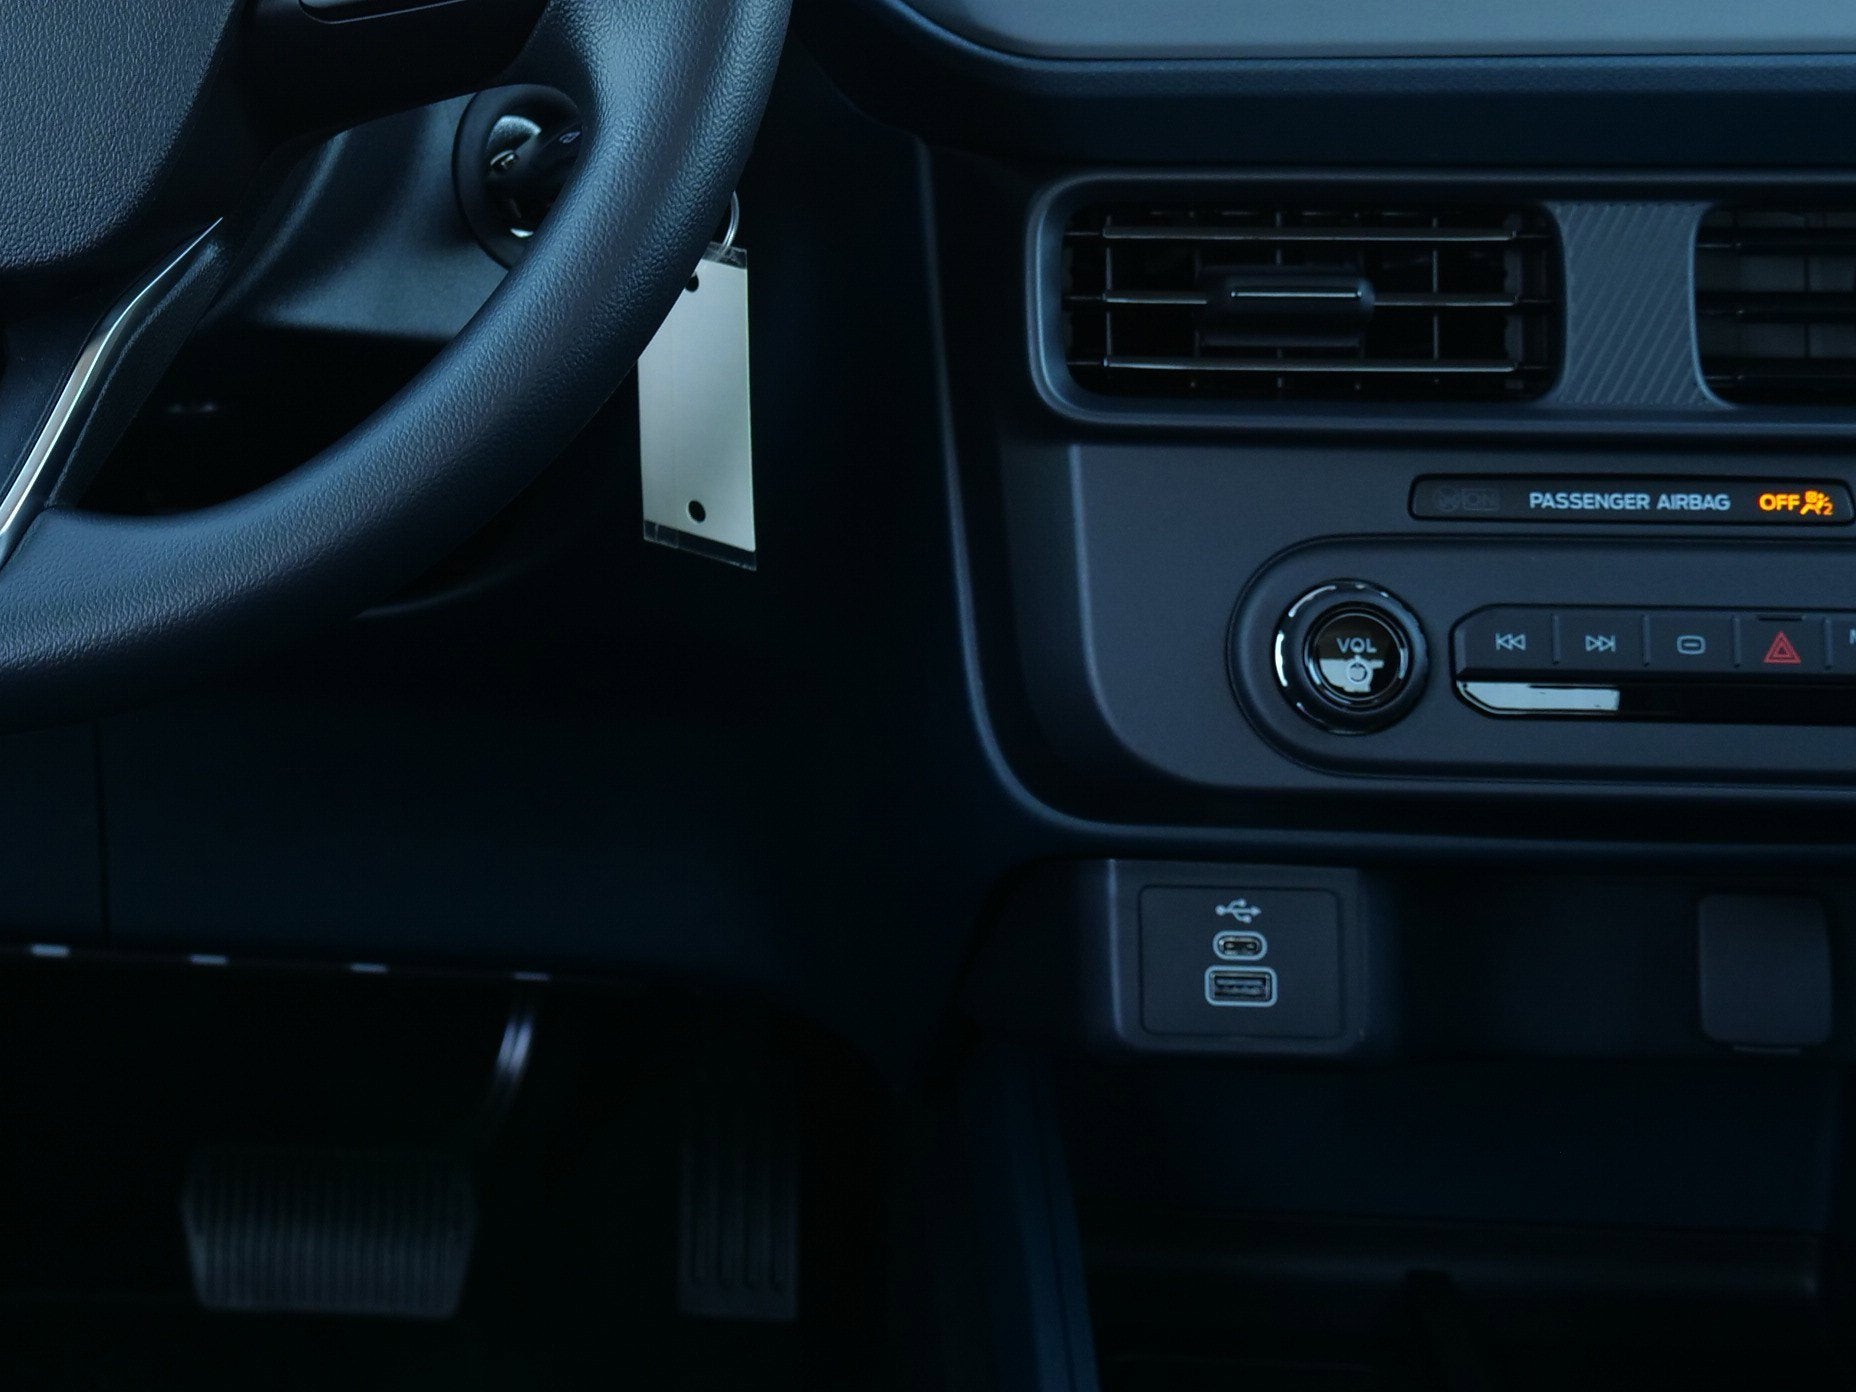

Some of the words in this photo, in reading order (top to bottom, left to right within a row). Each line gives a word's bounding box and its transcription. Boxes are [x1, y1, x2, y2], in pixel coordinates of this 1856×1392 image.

[1529, 491, 1652, 511] PASSENGER
[1656, 492, 1732, 512] AIRBAG
[1758, 493, 1801, 512] OFF
[1335, 636, 1378, 654] VOL
